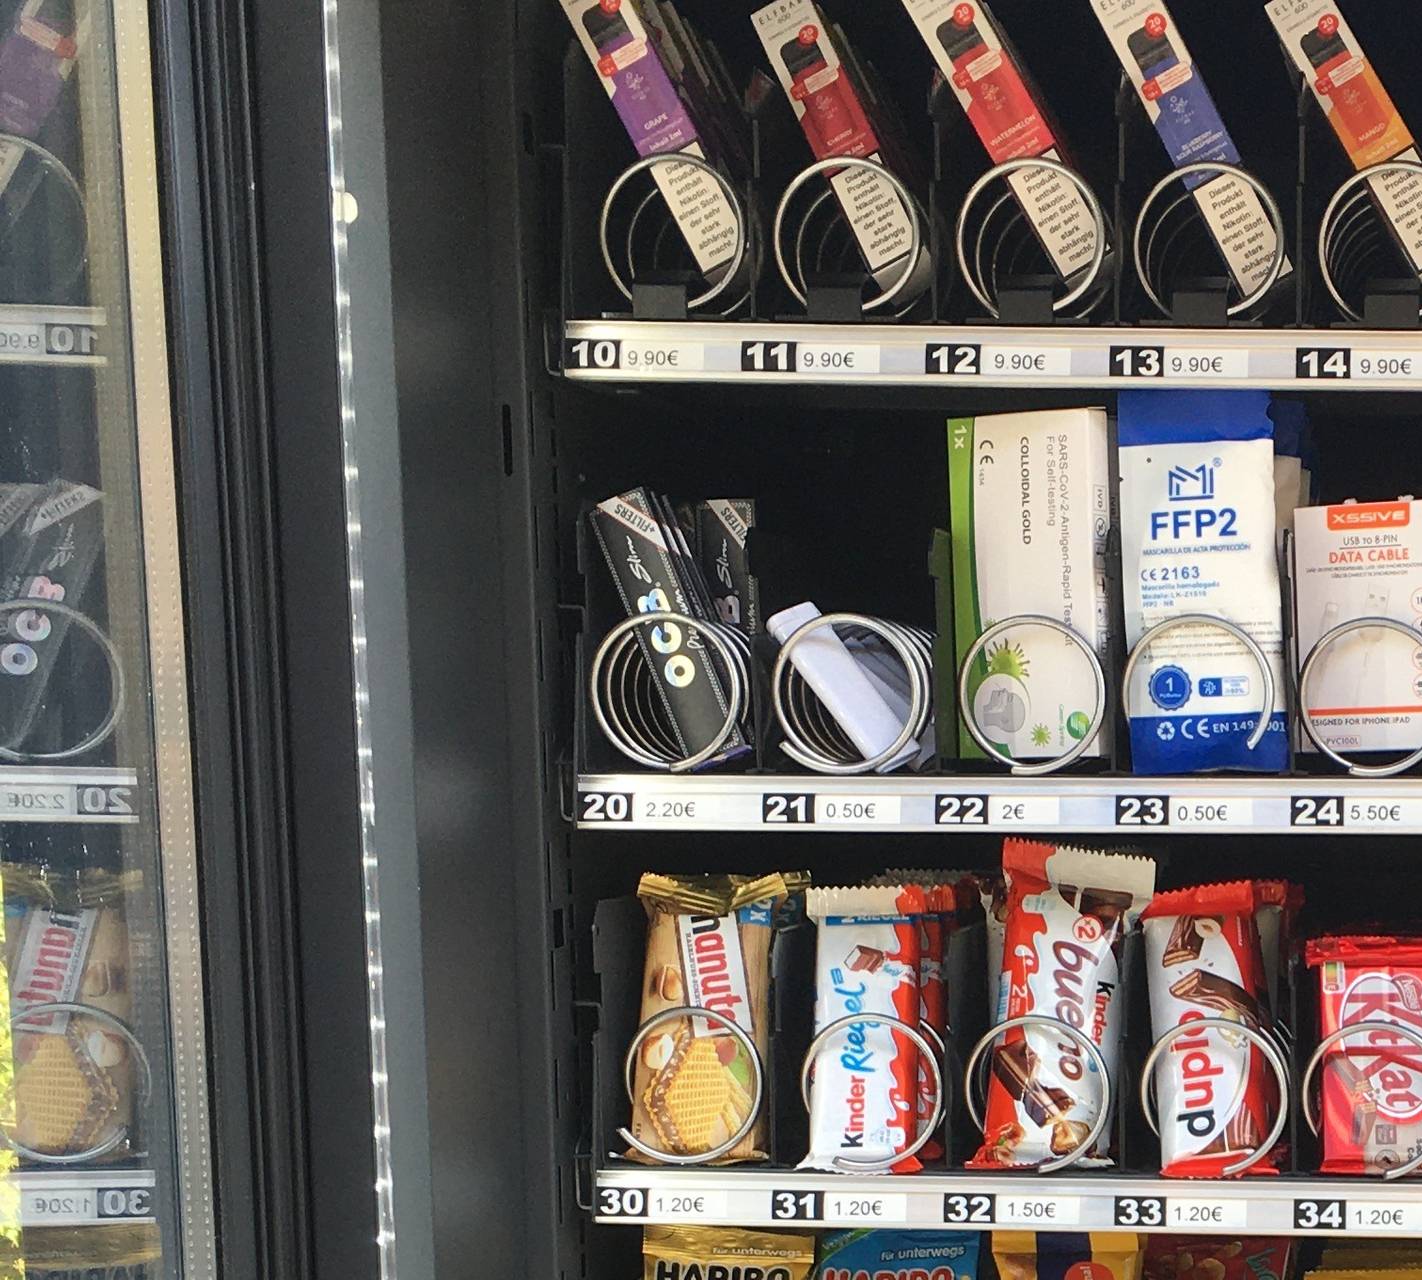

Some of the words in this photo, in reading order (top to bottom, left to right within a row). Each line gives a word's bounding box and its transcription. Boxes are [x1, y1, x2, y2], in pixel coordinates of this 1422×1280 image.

[990, 115, 1037, 147] WATERMELON
[572, 341, 617, 368] 10
[627, 350, 679, 367] 9.90€
[746, 343, 791, 371] 11
[803, 352, 854, 368] 9.90€
[931, 345, 977, 373] 12
[994, 353, 1046, 371] 9.90€
[1115, 349, 1160, 376] 13
[1171, 356, 1223, 373] 9.90€
[1301, 351, 1348, 378] 14
[1360, 358, 1412, 374] 9.90€
[1046, 436, 1054, 457] For
[1020, 436, 1031, 508] COLLOIDAL
[1047, 461, 1055, 527] Self-testing
[1022, 509, 1032, 545] GOLD
[1151, 508, 1238, 541] FFP2
[1332, 510, 1406, 524] XSSIVE
[1343, 535, 1360, 546] USB
[626, 535, 653, 584] Slim
[716, 538, 732, 589] Slim
[1328, 550, 1364, 564] DATA
[1368, 548, 1410, 562] CABLE
[1161, 566, 1200, 580] 2163
[1213, 723, 1229, 733] EN
[1345, 718, 1360, 726] FOR
[583, 794, 628, 820] 20
[646, 802, 696, 818] 2.20€
[766, 795, 809, 822] 21
[826, 802, 876, 819] 0.50€
[938, 797, 985, 823] 22
[1002, 804, 1025, 820] 2€
[1119, 798, 1165, 824] 23
[1177, 805, 1228, 821] 0.50€
[1294, 799, 1340, 825] 24
[1350, 805, 1401, 822] 5.50€
[1052, 941, 1099, 1081] bueno
[1170, 1011, 1224, 1137] duplo
[600, 1189, 644, 1215] 30
[656, 1197, 705, 1213] 1.20€
[775, 1193, 818, 1219] 31
[834, 1200, 883, 1217] 1.20€
[947, 1196, 992, 1222] 32
[1007, 1202, 1056, 1219] 1.50€
[1118, 1199, 1163, 1225] 33
[1174, 1206, 1223, 1222] 1.20€
[1298, 1202, 1343, 1228] 34
[1355, 1209, 1404, 1226] 1.20€
[732, 1247, 802, 1258] unterwegs
[880, 1252, 895, 1261] für
[898, 1246, 965, 1259] unterwegs
